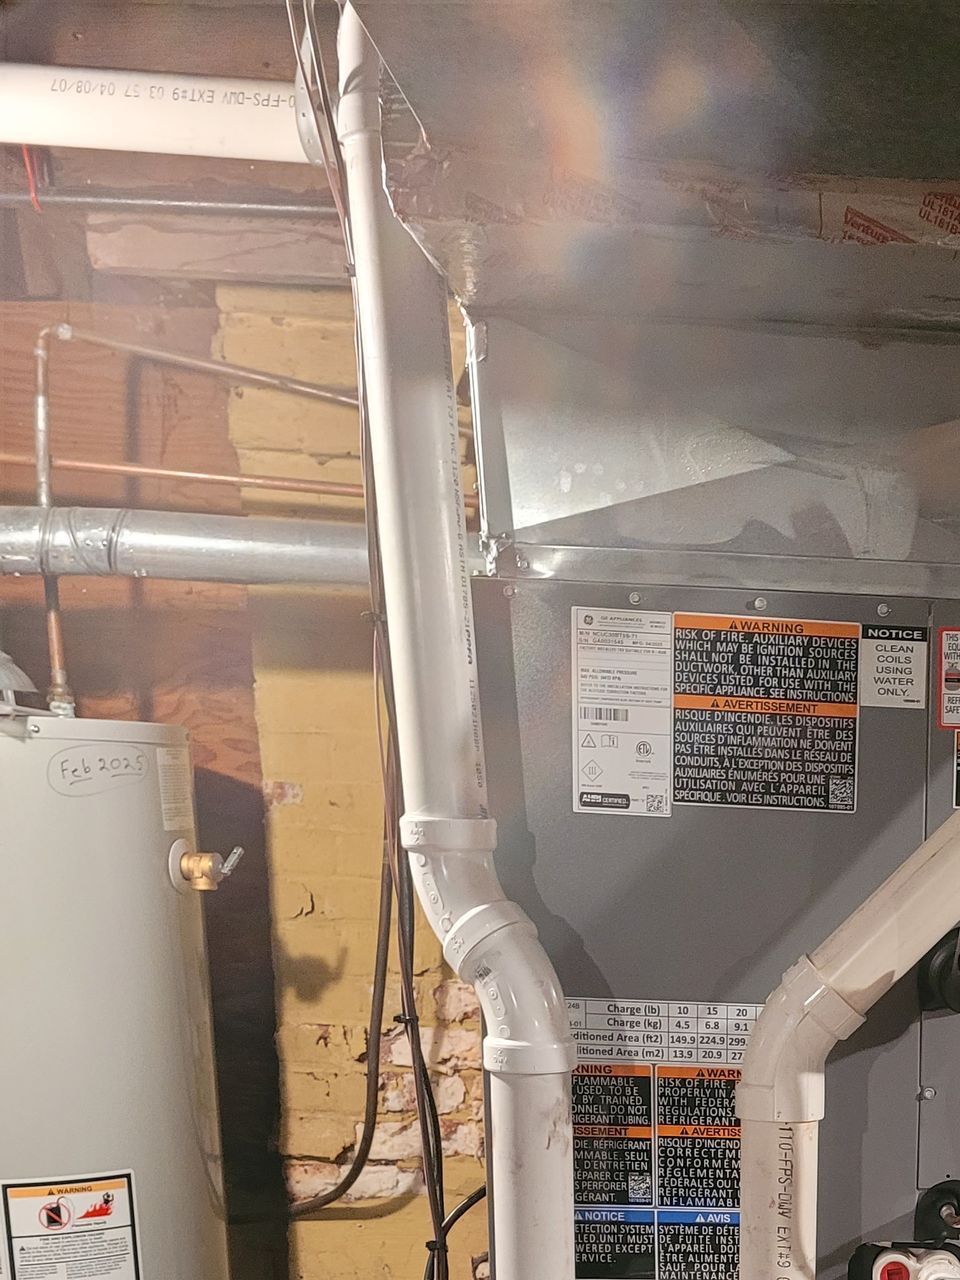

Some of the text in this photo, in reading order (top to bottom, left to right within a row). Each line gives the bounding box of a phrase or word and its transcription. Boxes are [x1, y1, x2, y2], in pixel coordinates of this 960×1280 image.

[50, 78, 214, 103] EXT#9 04/08/07
[741, 621, 804, 633] WARNING
[675, 629, 857, 648] RISK OF FIRE. AUXILIARY DEVICES
[868, 629, 923, 639] NOTICE
[946, 633, 959, 641] THIS
[675, 640, 856, 659] WHICH MAY BE IGNITION SOURCES
[875, 644, 914, 653] CLEAN
[675, 651, 856, 670] SHALL NOT BE INSTALLED IN THE
[877, 655, 912, 664] COILS
[944, 652, 960, 660] WITH
[675, 662, 856, 681] DUCTWORK, OTHER THAN AUXILIARY
[876, 666, 912, 675] USING
[675, 673, 856, 692] DEVICES LISTED FOR USE WITH THE
[873, 677, 914, 686] WATER
[675, 683, 714, 694] SPECIFIC
[716, 686, 768, 698] APPLIANCE.
[769, 688, 785, 698] SEE
[787, 690, 856, 703] INSTRUCTIONS.
[878, 688, 910, 696] ONLY.
[723, 699, 819, 713] AVERTISSEMENT
[675, 710, 854, 729] RISQUE D'INCENDIE. LES DISPOSITIFS
[675, 722, 853, 740] AUXILIAIRES QUI PEUVENT ÊTRE DES
[60, 755, 144, 779] Feb 2025
[607, 1004, 748, 1017] Charge (lb) 10 15 20
[607, 1017, 749, 1031] Charge (kg) 4.5 6.8 9.1
[616, 1033, 639, 1043] Area
[642, 1033, 663, 1044] (ft2)
[670, 1035, 696, 1044] 149.9
[699, 1036, 725, 1045] 224.9
[616, 1048, 639, 1057] Area
[642, 1048, 664, 1059] (m2)
[673, 1050, 693, 1059] 13.9
[702, 1050, 722, 1059] 20.9
[573, 1077, 634, 1086] FLAMMABLE
[658, 1078, 731, 1089] RISK OF FIRE.
[577, 1086, 639, 1096] USED. TO BE
[658, 1087, 726, 1098] PROPERLY IN
[582, 1095, 643, 1106] BY TRAINED
[658, 1096, 687, 1106] WITH
[610, 1105, 646, 1115] DO NOT
[617, 1116, 650, 1125] TUBING.
[658, 1116, 736, 1125] REFRIGERANT
[593, 1139, 651, 1150] RÉFRIGÉRANT
[659, 1138, 692, 1147] RISQUE
[624, 1152, 649, 1161] SEUL
[57, 1186, 92, 1194] WARNING
[582, 1180, 627, 1191] PERFORER
[584, 1211, 625, 1221] NOTICE
[707, 1213, 731, 1222] AVIS
[620, 1225, 654, 1234] SYSTEM
[659, 1224, 714, 1235] SYSTÈME DE
[627, 1235, 654, 1243] MUST
[615, 1245, 653, 1253] EXCEPT
[776, 1227, 792, 1268] EXT#9
[660, 1271, 739, 1280] MAINTENANCE
